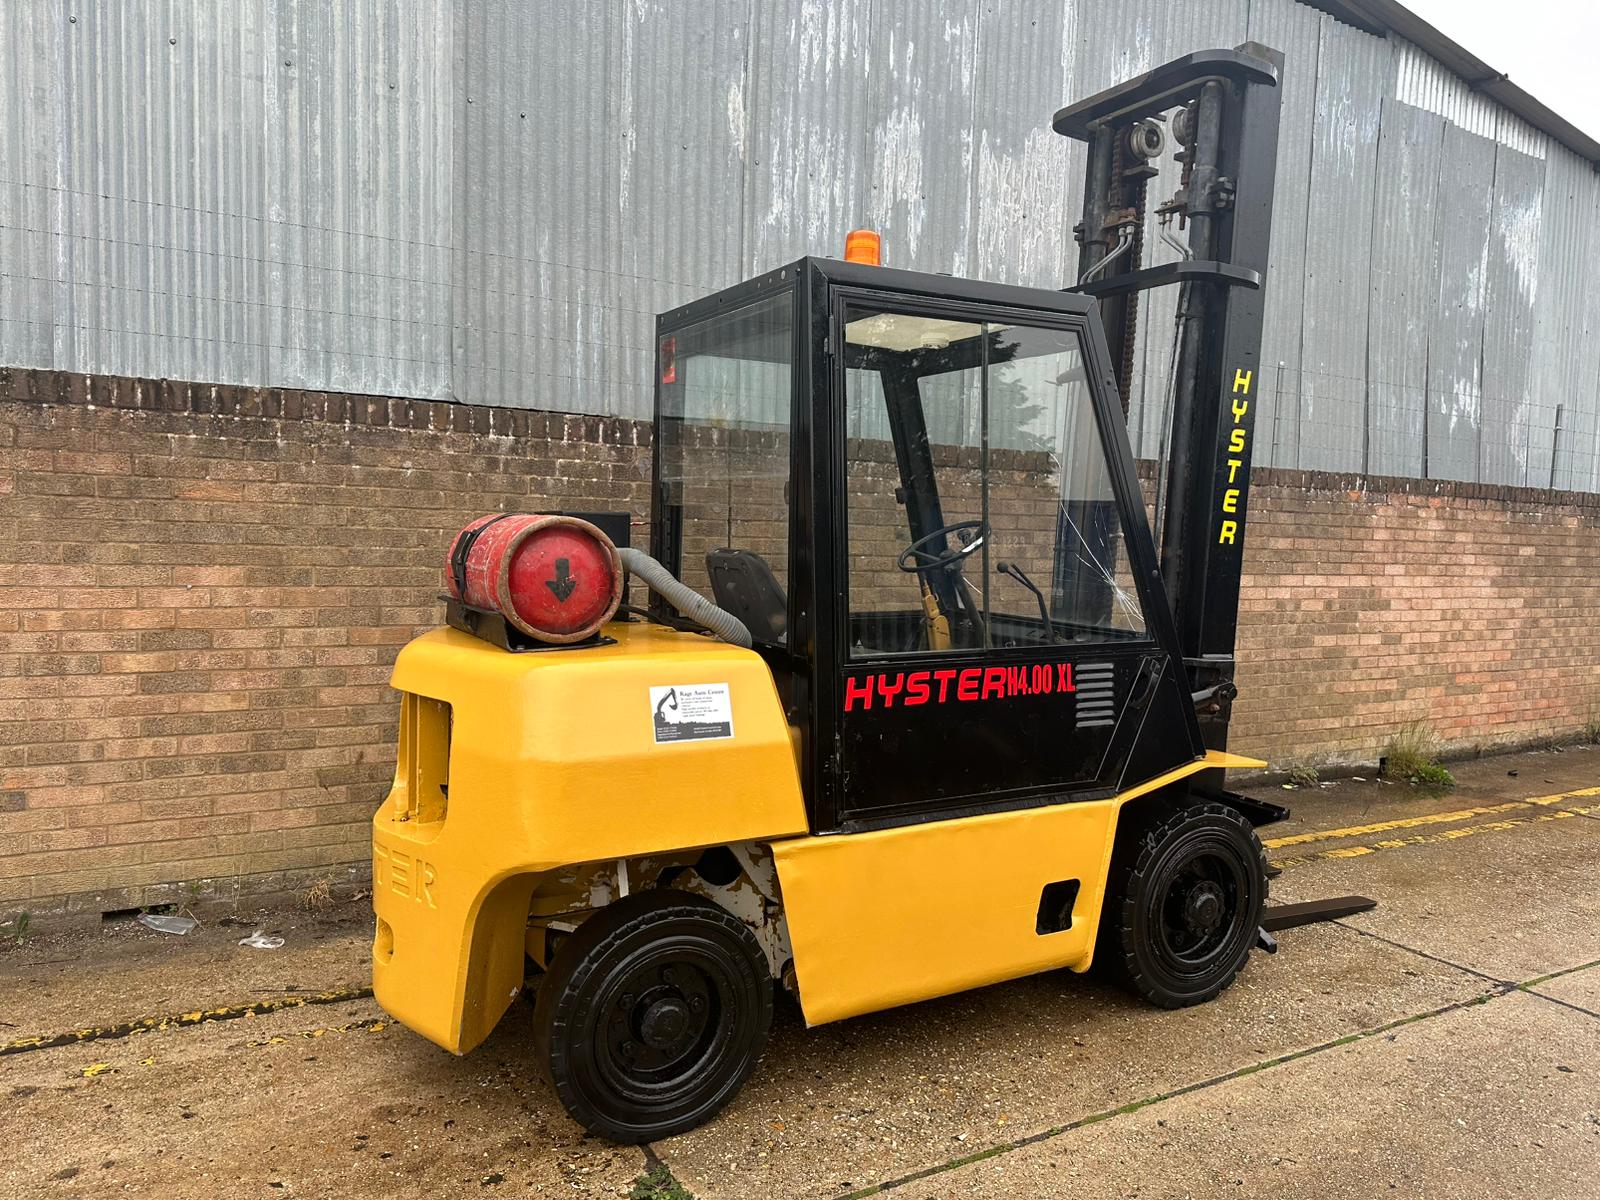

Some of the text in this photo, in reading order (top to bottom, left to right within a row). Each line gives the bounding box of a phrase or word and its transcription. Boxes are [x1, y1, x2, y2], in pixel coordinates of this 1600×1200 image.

[1219, 369, 1252, 544] HYSTER
[844, 663, 1076, 712] HYSTER H4.00 XL
